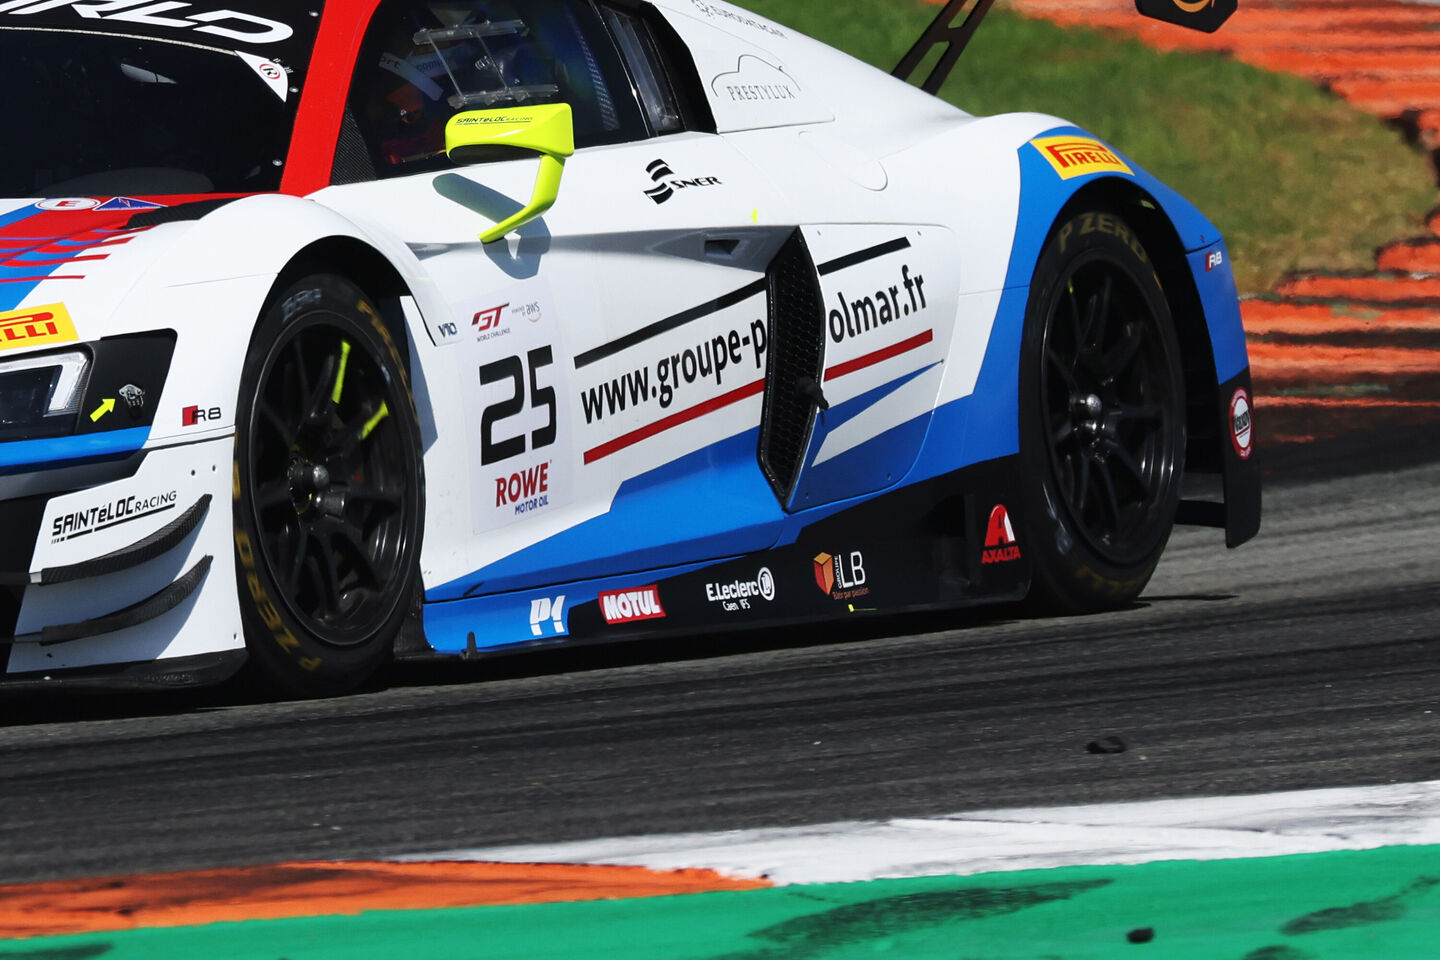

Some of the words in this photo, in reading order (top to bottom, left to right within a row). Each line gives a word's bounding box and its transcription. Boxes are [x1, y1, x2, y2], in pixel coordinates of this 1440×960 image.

[726, 84, 795, 101] PRESTYLUX
[1045, 142, 1123, 168] PIRELLI
[670, 175, 723, 190] SNER
[479, 344, 557, 467] 25
[495, 461, 549, 508] ROWE
[514, 498, 538, 516] MOTOR
[538, 494, 549, 509] OIL
[981, 545, 1022, 565] AXALTA
[705, 579, 759, 602] E.Leclerc
[602, 590, 662, 621] MOTUL
